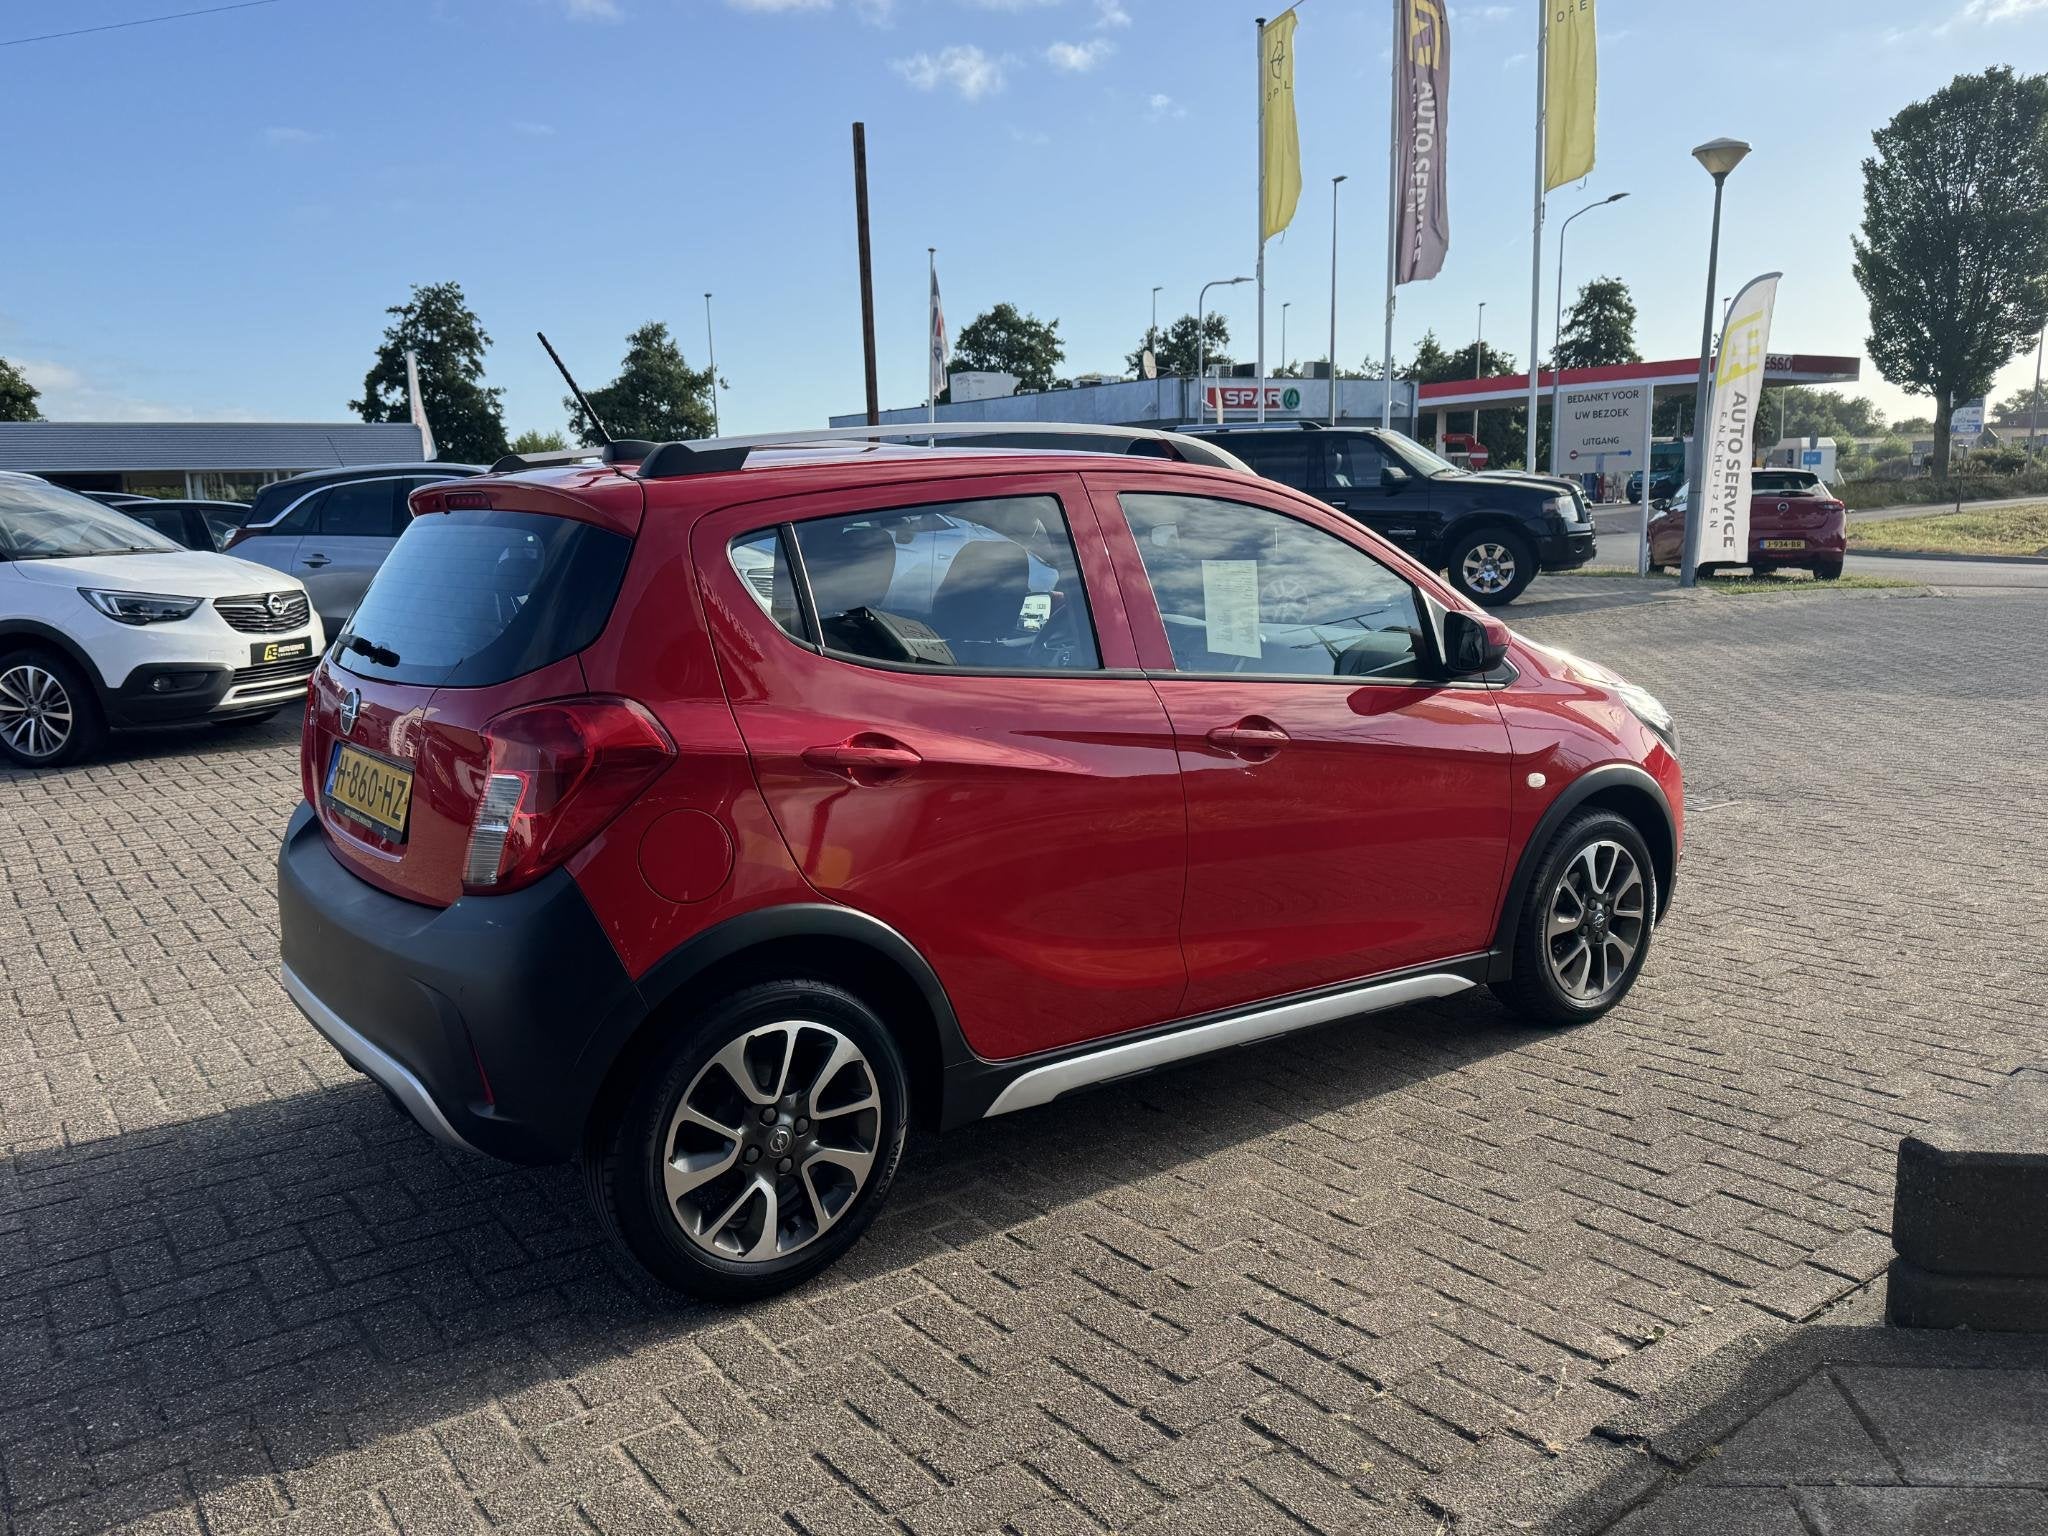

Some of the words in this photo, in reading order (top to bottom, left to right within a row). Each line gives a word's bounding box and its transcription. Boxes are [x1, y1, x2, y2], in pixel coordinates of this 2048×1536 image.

[1557, 0, 1588, 22] OPE
[1267, 80, 1292, 102] OPL
[1416, 81, 1436, 153] AUTO
[1567, 392, 1610, 404] BEDANKT
[1612, 389, 1640, 400] VOOR
[1575, 411, 1591, 420] UW
[1592, 407, 1629, 419] BEZOEK
[1582, 436, 1620, 446] UITGANG
[1727, 391, 1748, 454] AUTO
[1709, 411, 1728, 528] ENKHUIZEN
[1723, 459, 1741, 548] SERVICE
[335, 754, 407, 821] H-860-HZ
